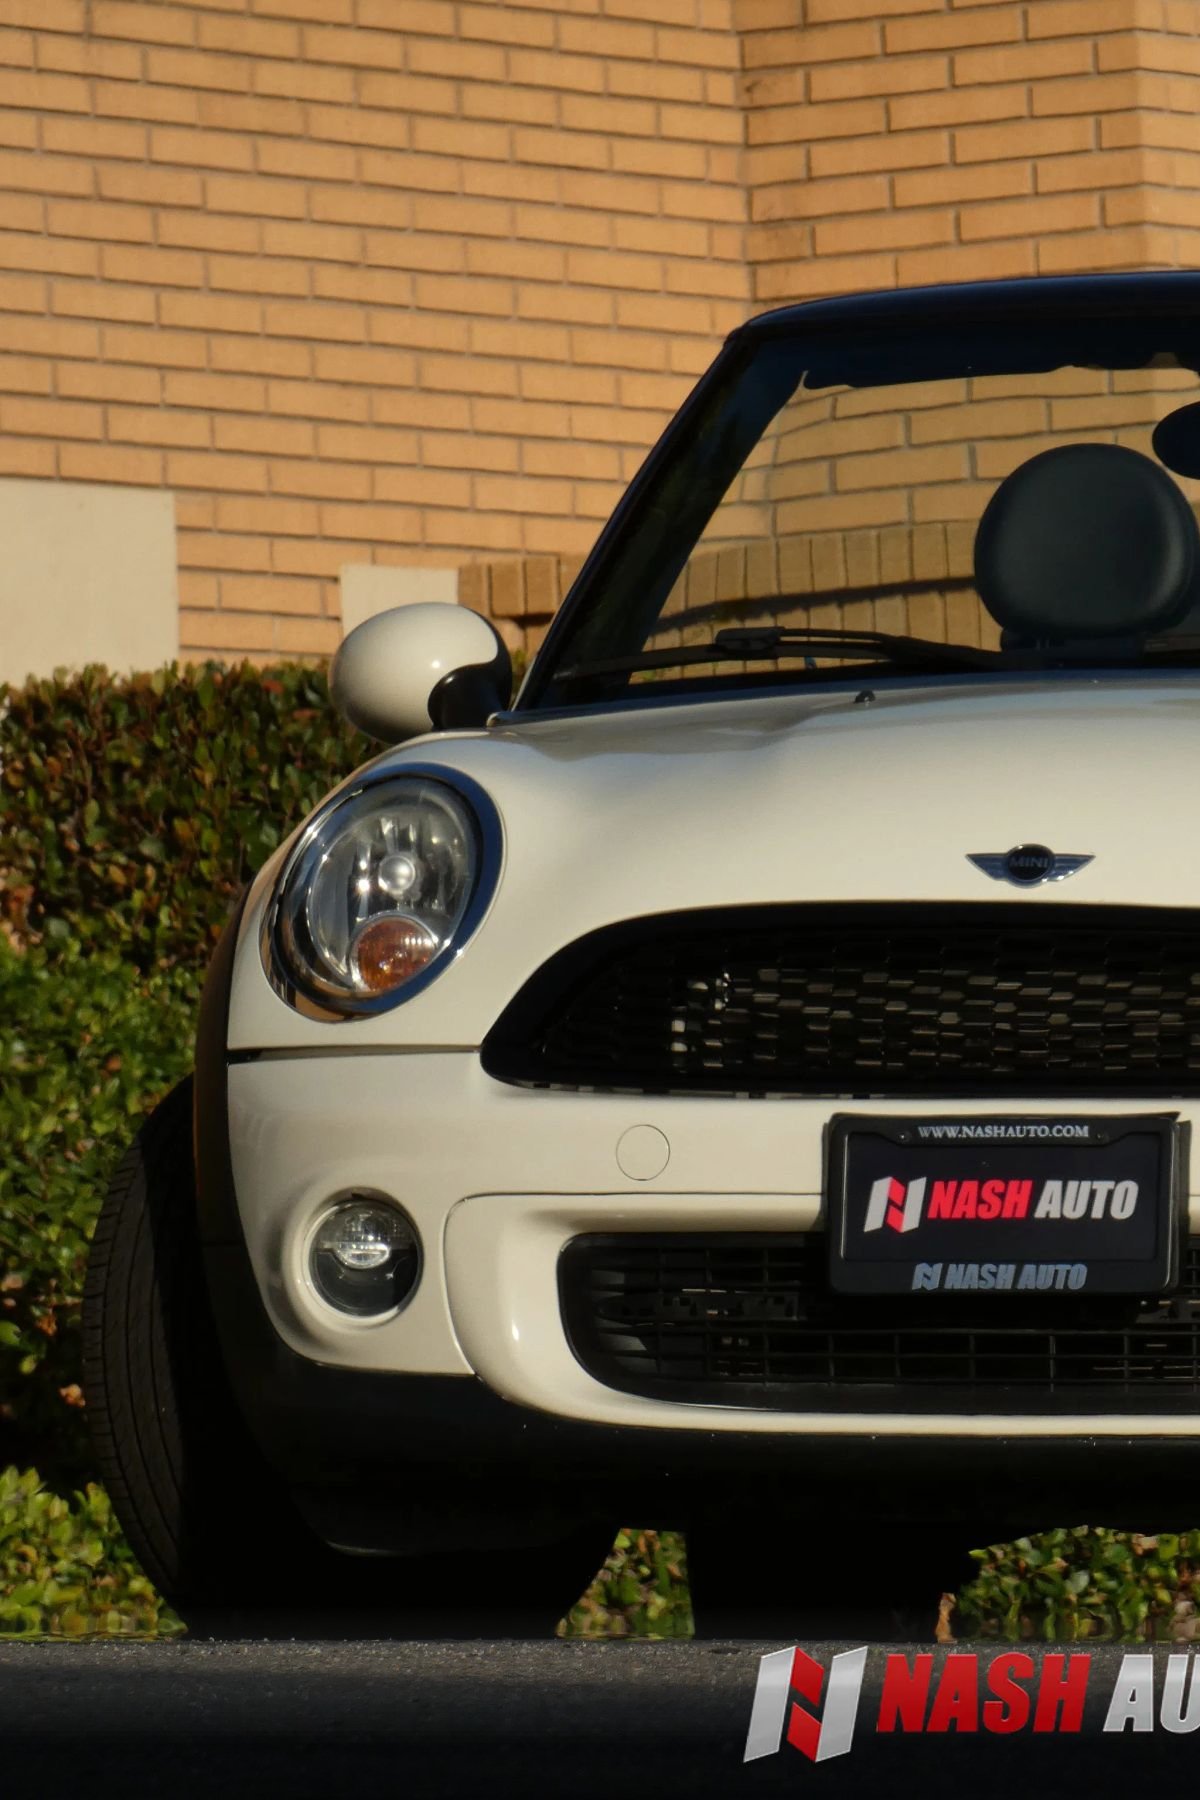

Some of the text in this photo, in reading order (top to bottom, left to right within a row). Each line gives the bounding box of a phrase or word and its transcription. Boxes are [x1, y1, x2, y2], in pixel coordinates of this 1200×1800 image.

[1010, 855, 1049, 868] MINI
[918, 1125, 1089, 1138] WWW.NASHAUTO.COM
[927, 1179, 1033, 1220] NASH
[1034, 1179, 1139, 1220] AUTO
[943, 1263, 1016, 1290] NASH
[1016, 1263, 1088, 1290] AUTO
